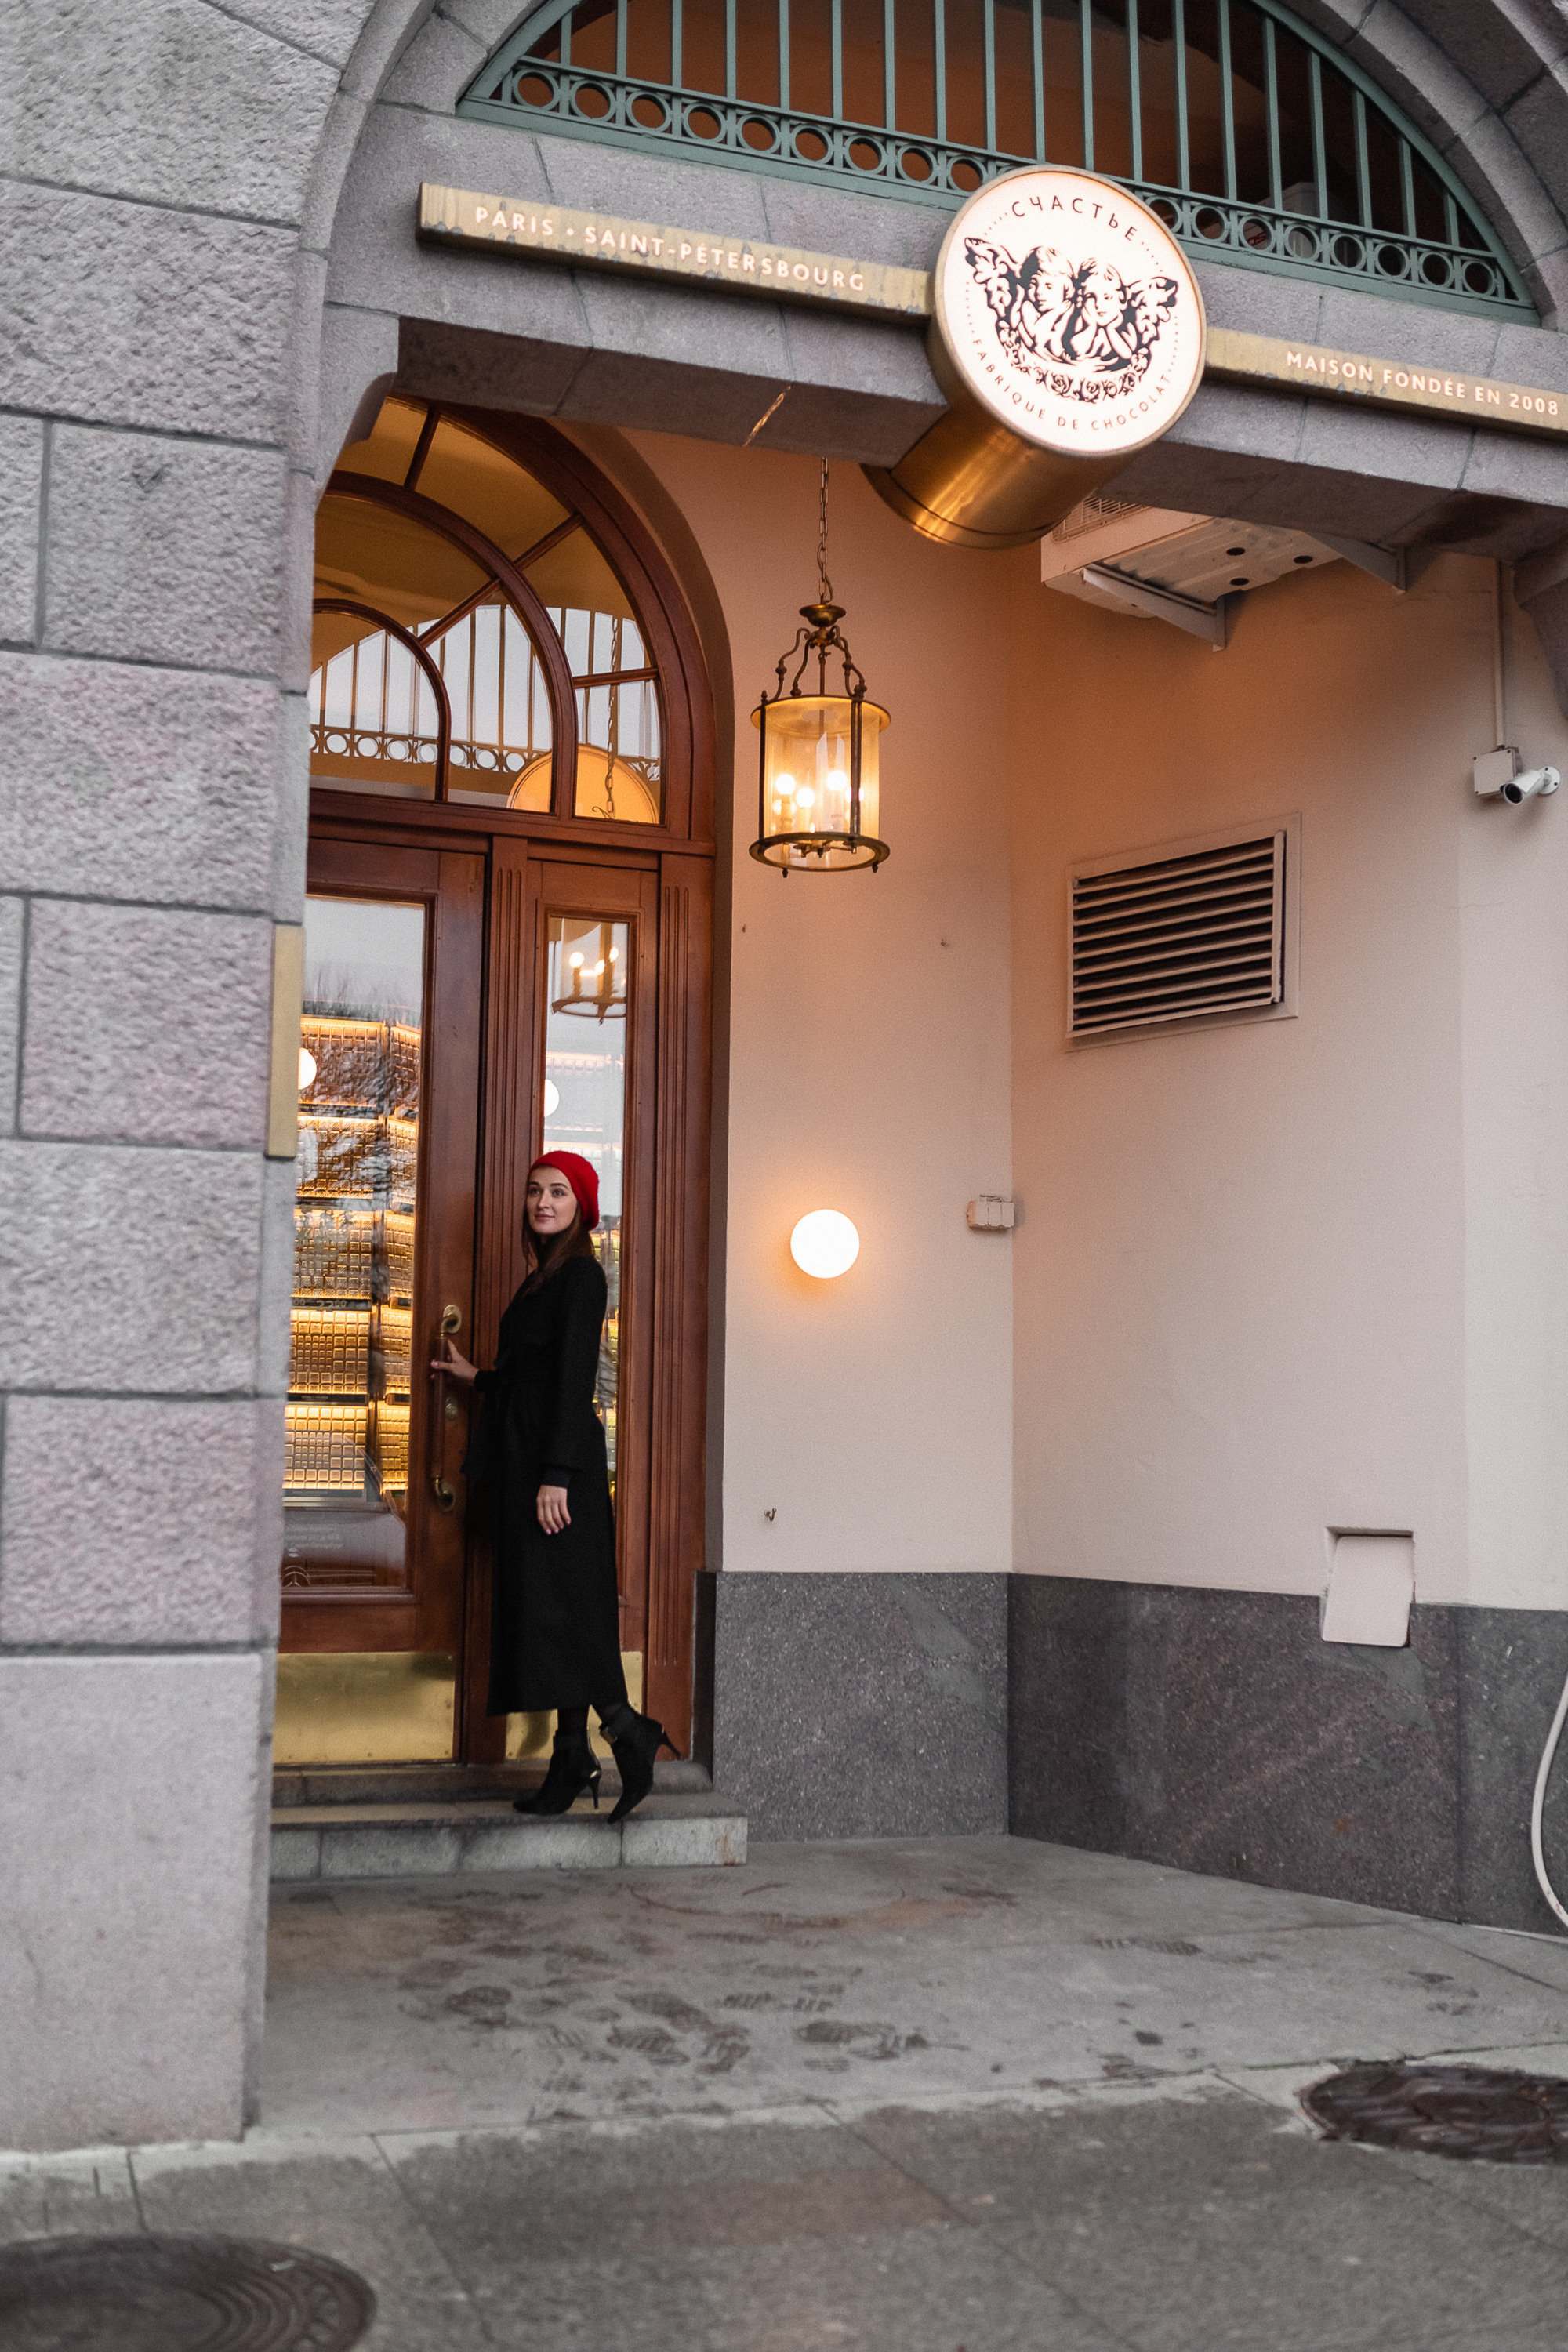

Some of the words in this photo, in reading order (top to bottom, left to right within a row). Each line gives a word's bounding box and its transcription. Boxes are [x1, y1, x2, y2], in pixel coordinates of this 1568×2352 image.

[475, 206, 554, 236] PARIS
[1012, 195, 1137, 241] СЧАСТЬЕ
[972, 339, 1045, 419] FABRIQUE
[1058, 416, 1078, 430] DE
[1091, 375, 1171, 430] CHOCOLAT
[1287, 350, 1374, 382] MAISON
[1383, 368, 1466, 398] FONDÉE
[1475, 386, 1501, 405] EN
[1510, 394, 1559, 416] 2008
